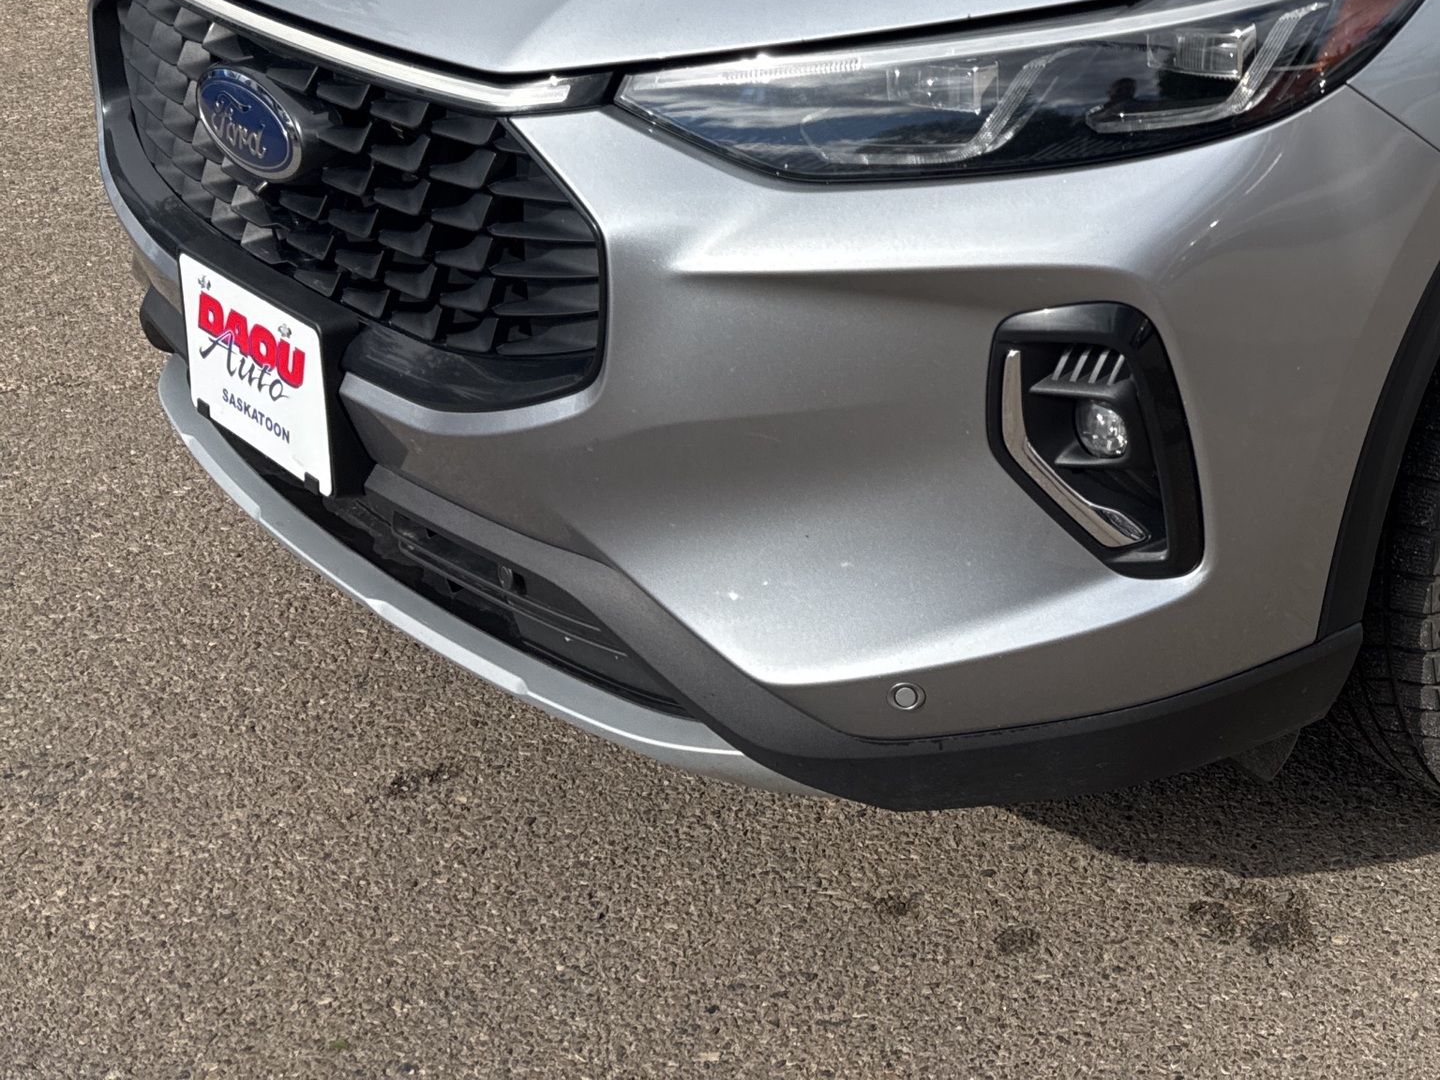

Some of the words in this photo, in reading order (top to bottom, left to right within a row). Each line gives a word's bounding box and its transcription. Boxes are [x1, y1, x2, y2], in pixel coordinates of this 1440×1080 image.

[211, 91, 267, 160] Ford
[198, 291, 305, 389] DAOU
[199, 329, 290, 401] Auto
[222, 387, 291, 445] SASKATOON
